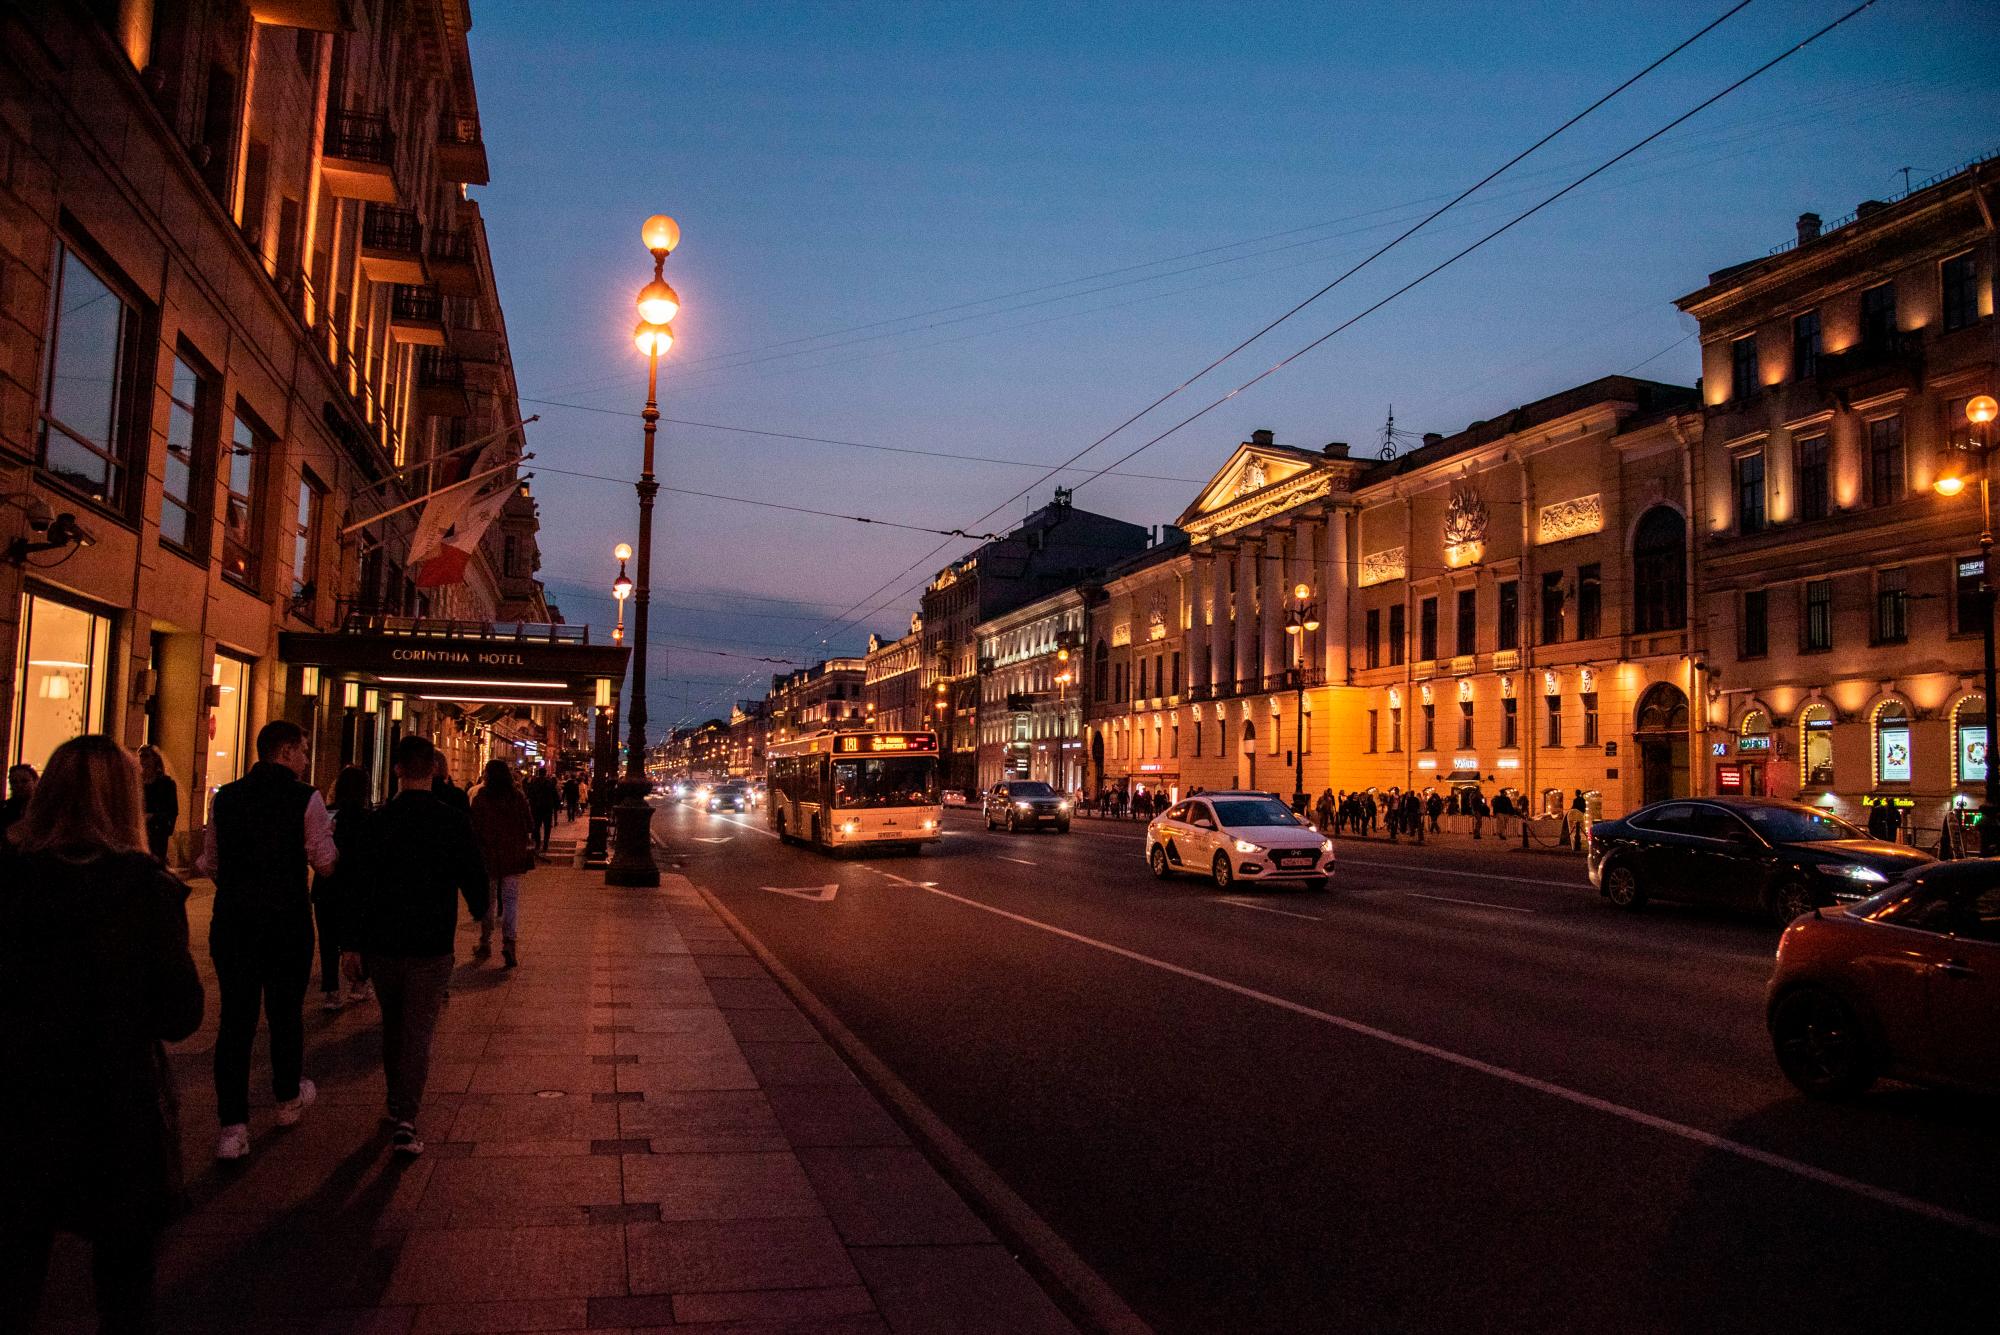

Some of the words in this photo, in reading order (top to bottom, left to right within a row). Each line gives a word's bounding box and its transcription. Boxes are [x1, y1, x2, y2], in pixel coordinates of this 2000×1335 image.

[392, 649, 469, 663] CORINTHIA
[479, 653, 524, 665] HOTEL
[844, 737, 858, 752] 181
[1712, 743, 1725, 756] 24
